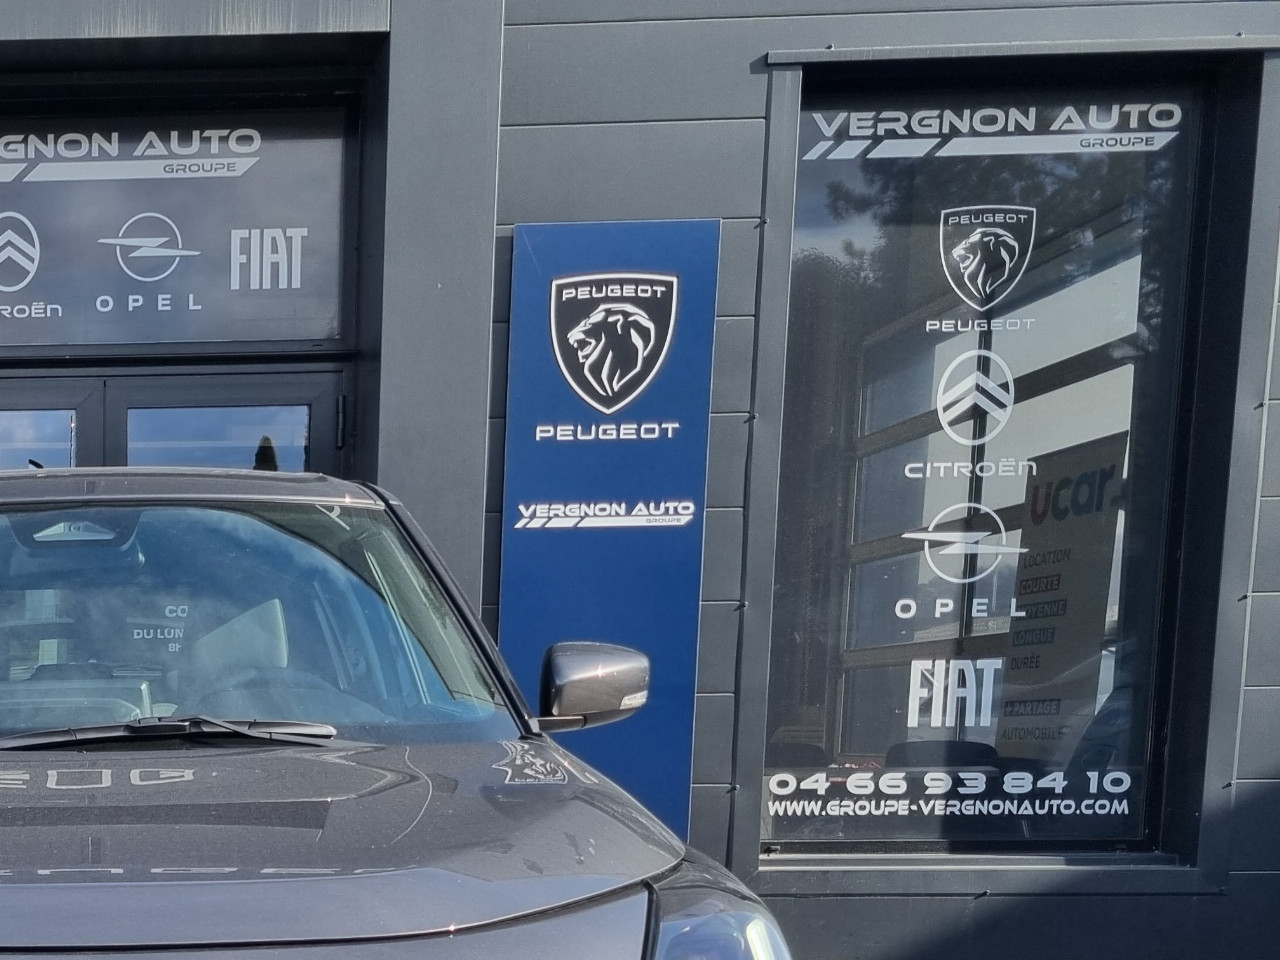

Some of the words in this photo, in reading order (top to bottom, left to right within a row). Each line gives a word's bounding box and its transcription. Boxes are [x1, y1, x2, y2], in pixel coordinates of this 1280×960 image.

[812, 107, 1036, 136] VERGNON
[1049, 103, 1182, 131] AUTO
[132, 128, 262, 157] AUTO
[1079, 135, 1156, 149] GROUPE
[163, 160, 237, 174] GROUPE
[948, 213, 1028, 226] PEUGEOT
[230, 227, 308, 290] FIAT
[562, 285, 666, 301] PEUGEOT
[95, 294, 202, 312] OPEL
[925, 318, 1036, 333] PEUGEOT
[535, 423, 680, 441] PEUGEOT
[518, 503, 625, 517] VERGNON
[630, 501, 695, 516] AUTO
[1023, 548, 1071, 569] LOCATION
[1020, 576, 1059, 596] COURTE
[894, 598, 1026, 619] OPEL
[1017, 601, 1066, 619] OYENNE
[133, 628, 154, 639] DU
[1014, 629, 1055, 647] LONGUE
[907, 659, 1002, 728] FIAT
[768, 772, 831, 796] 04
[846, 772, 907, 796] 66
[923, 771, 986, 796] 93
[1003, 771, 1068, 795] 84
[1086, 771, 1132, 795] 10
[767, 799, 1130, 817] WWW.GROUPE-VERGNONAUTO.COM
